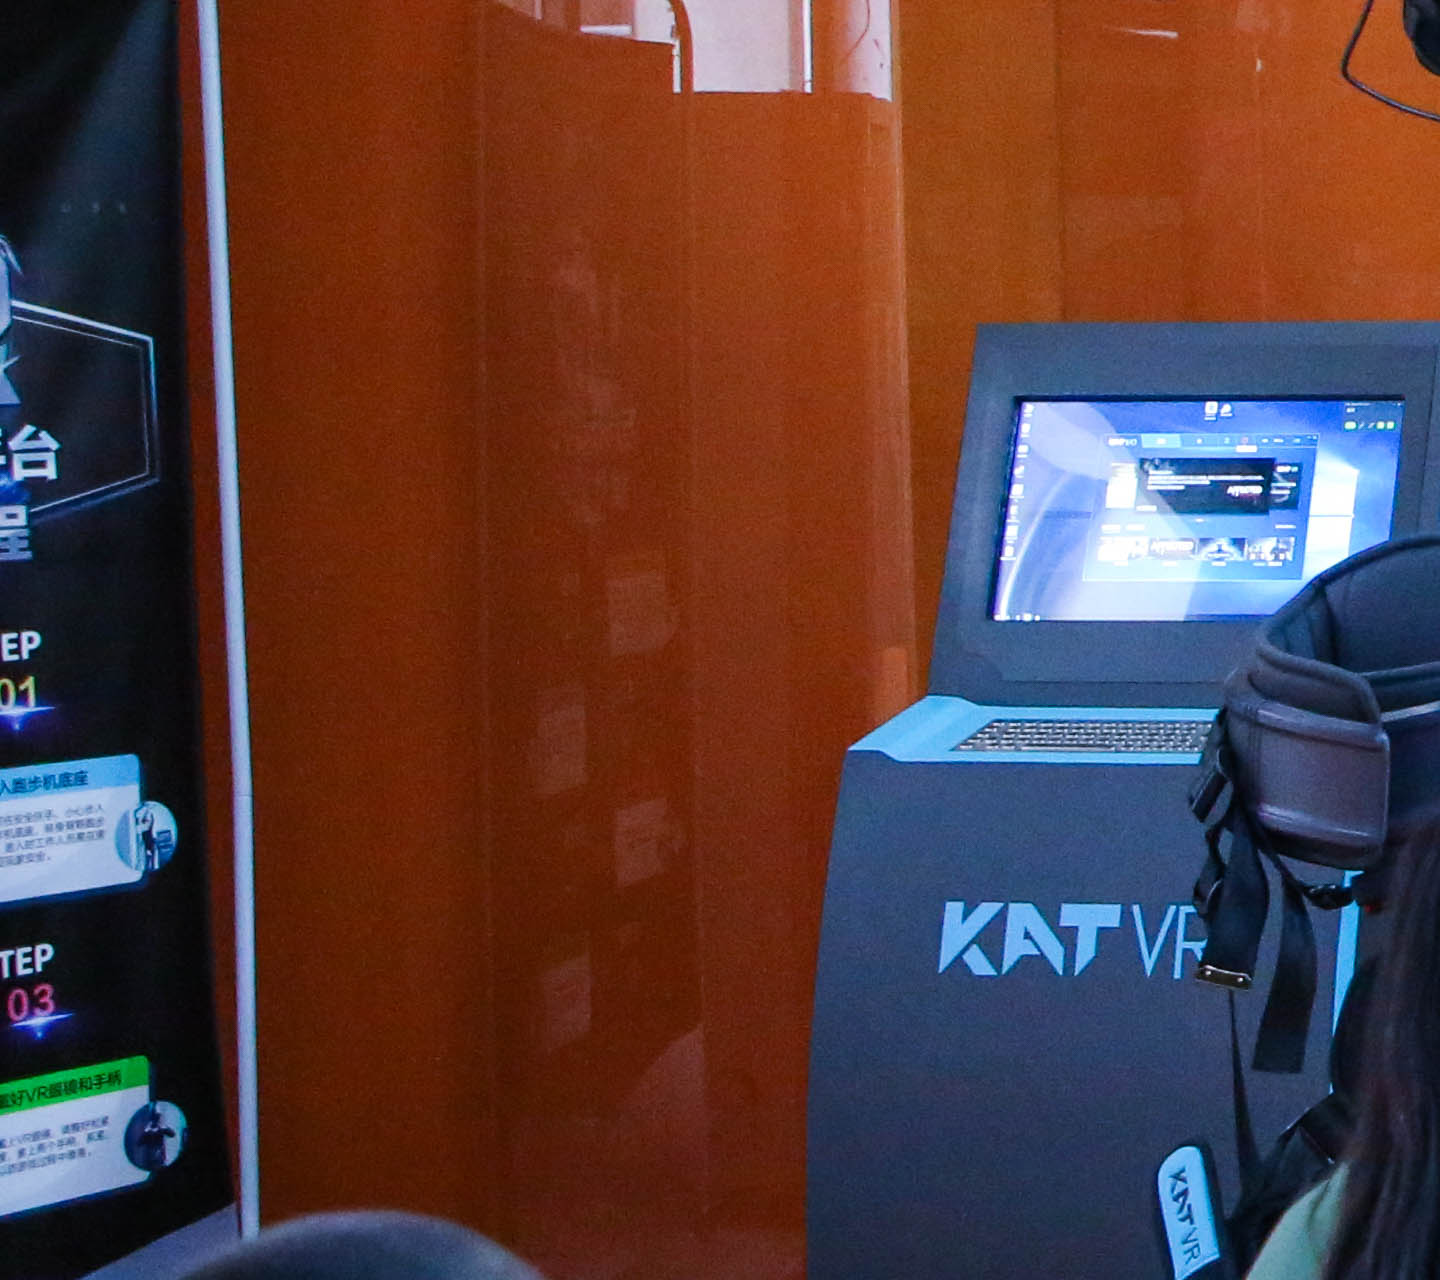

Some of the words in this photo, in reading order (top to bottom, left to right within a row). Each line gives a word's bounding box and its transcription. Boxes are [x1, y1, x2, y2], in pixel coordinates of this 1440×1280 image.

[938, 900, 1122, 976] KAT
[1132, 904, 1208, 979] VR
[8, 983, 55, 1021] 03
[1168, 1166, 1194, 1228] KAT
[1183, 1225, 1201, 1265] VR
